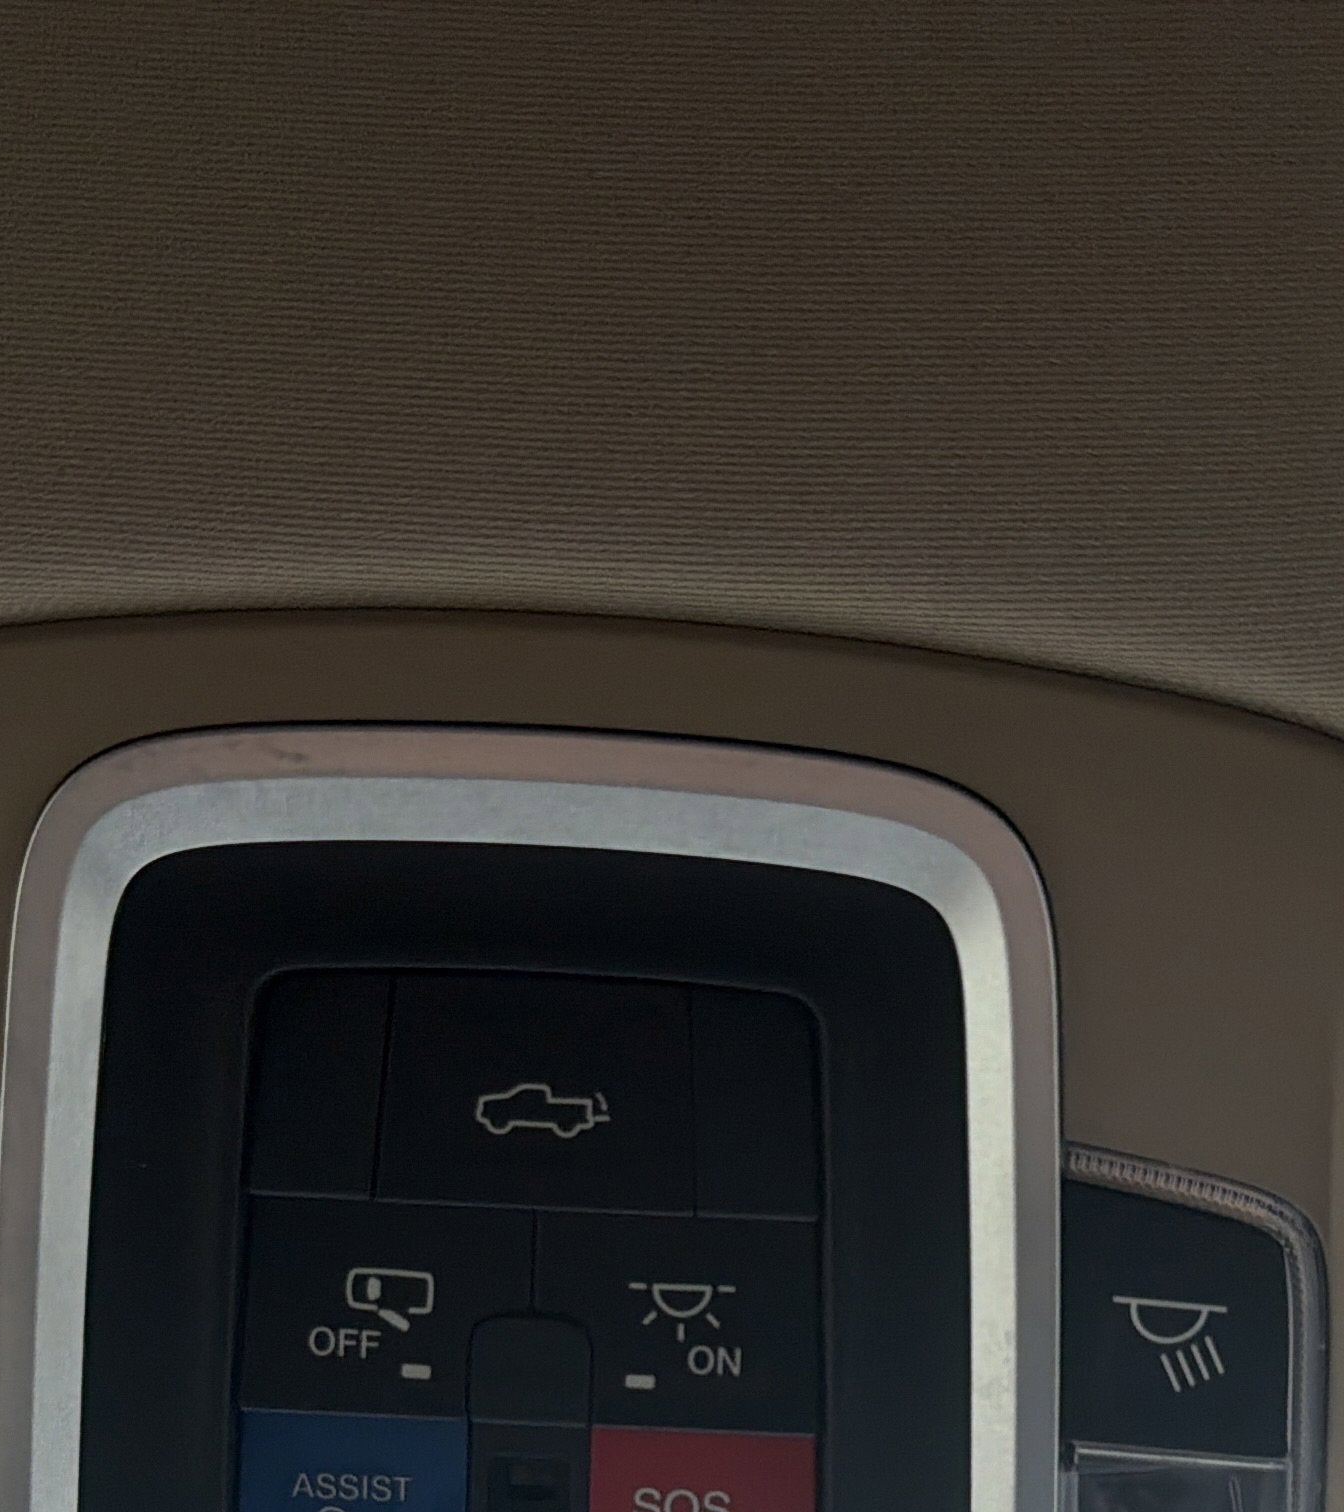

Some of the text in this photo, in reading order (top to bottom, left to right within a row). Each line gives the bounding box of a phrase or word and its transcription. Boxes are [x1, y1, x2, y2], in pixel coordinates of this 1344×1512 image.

[308, 1326, 381, 1360] OFF
[687, 1345, 742, 1378] ON
[291, 1472, 412, 1502] ASSIST
